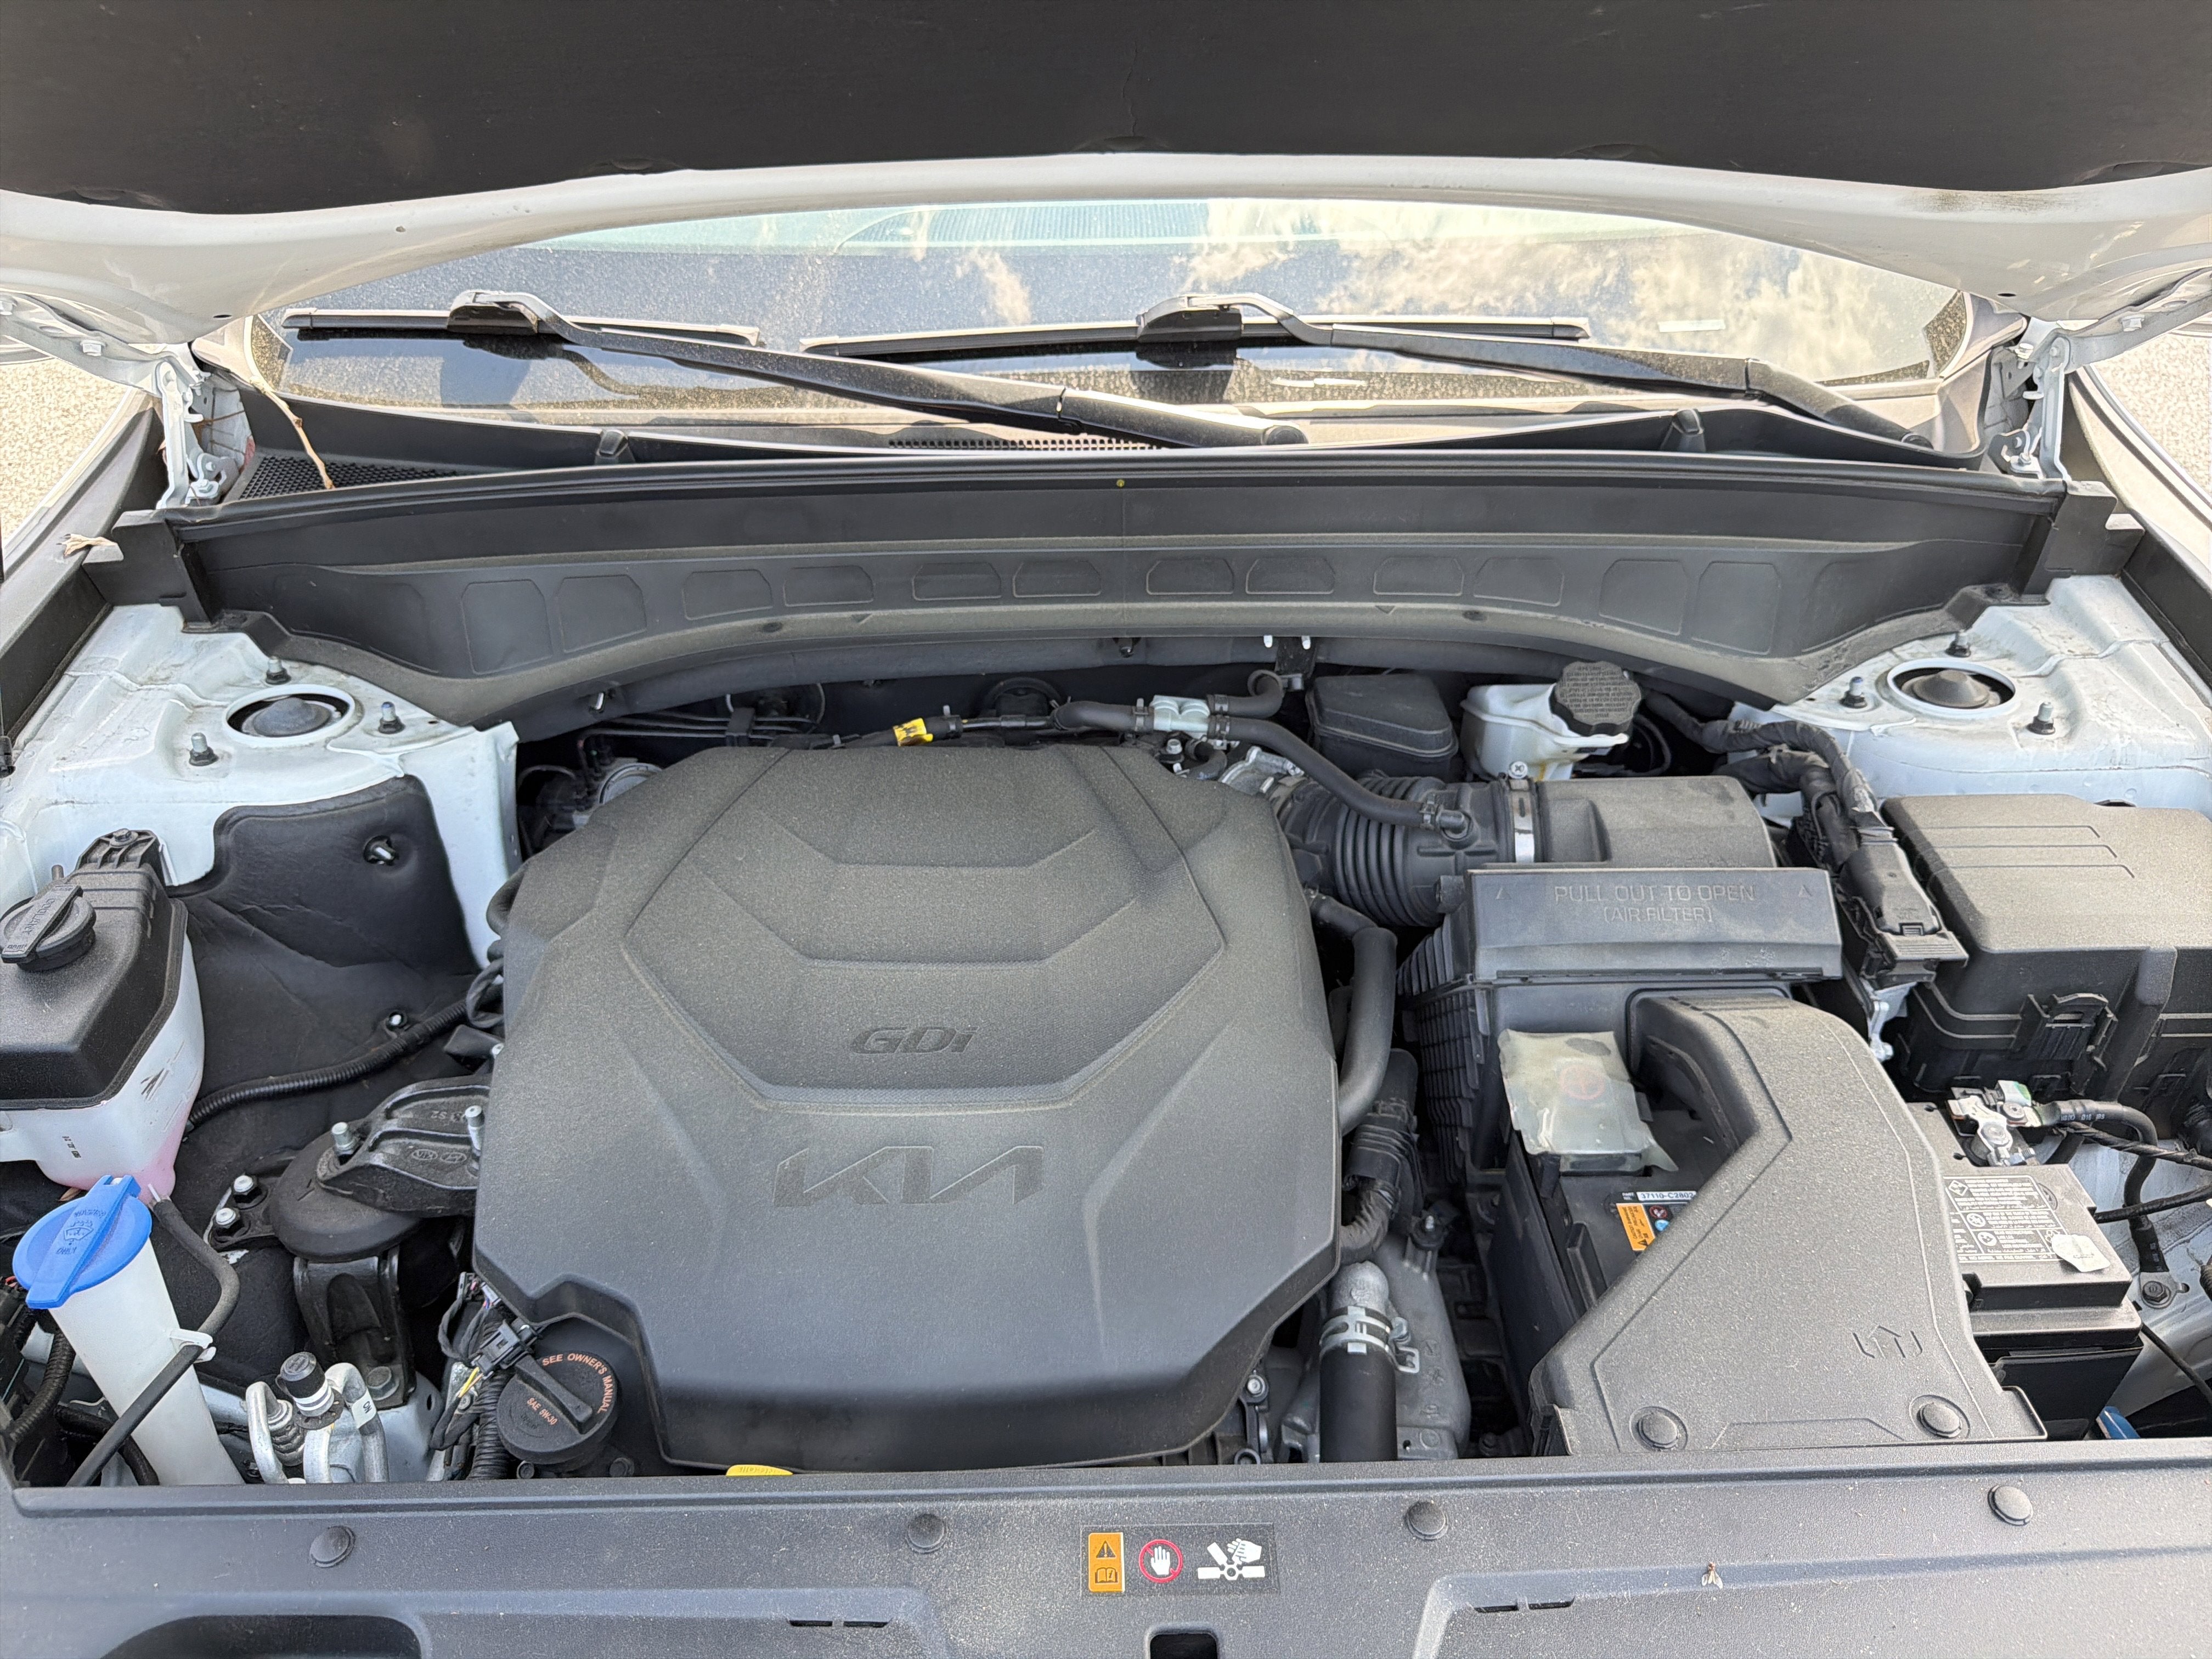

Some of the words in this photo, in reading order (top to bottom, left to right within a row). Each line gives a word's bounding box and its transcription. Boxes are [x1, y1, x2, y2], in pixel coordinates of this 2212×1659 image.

[1555, 885, 1608, 902] PULL
[1615, 885, 1657, 901] OUT
[1663, 885, 1691, 901] TO
[1699, 884, 1755, 901] OPEN
[22, 898, 56, 935] COOLANT
[772, 1146, 1043, 1207] KIA
[541, 1353, 564, 1367] SEE
[567, 1353, 608, 1375] OWNER'S
[596, 1375, 613, 1414] MANUAL
[527, 1397, 542, 1410] SAE
[539, 1408, 558, 1425] 5W-30
